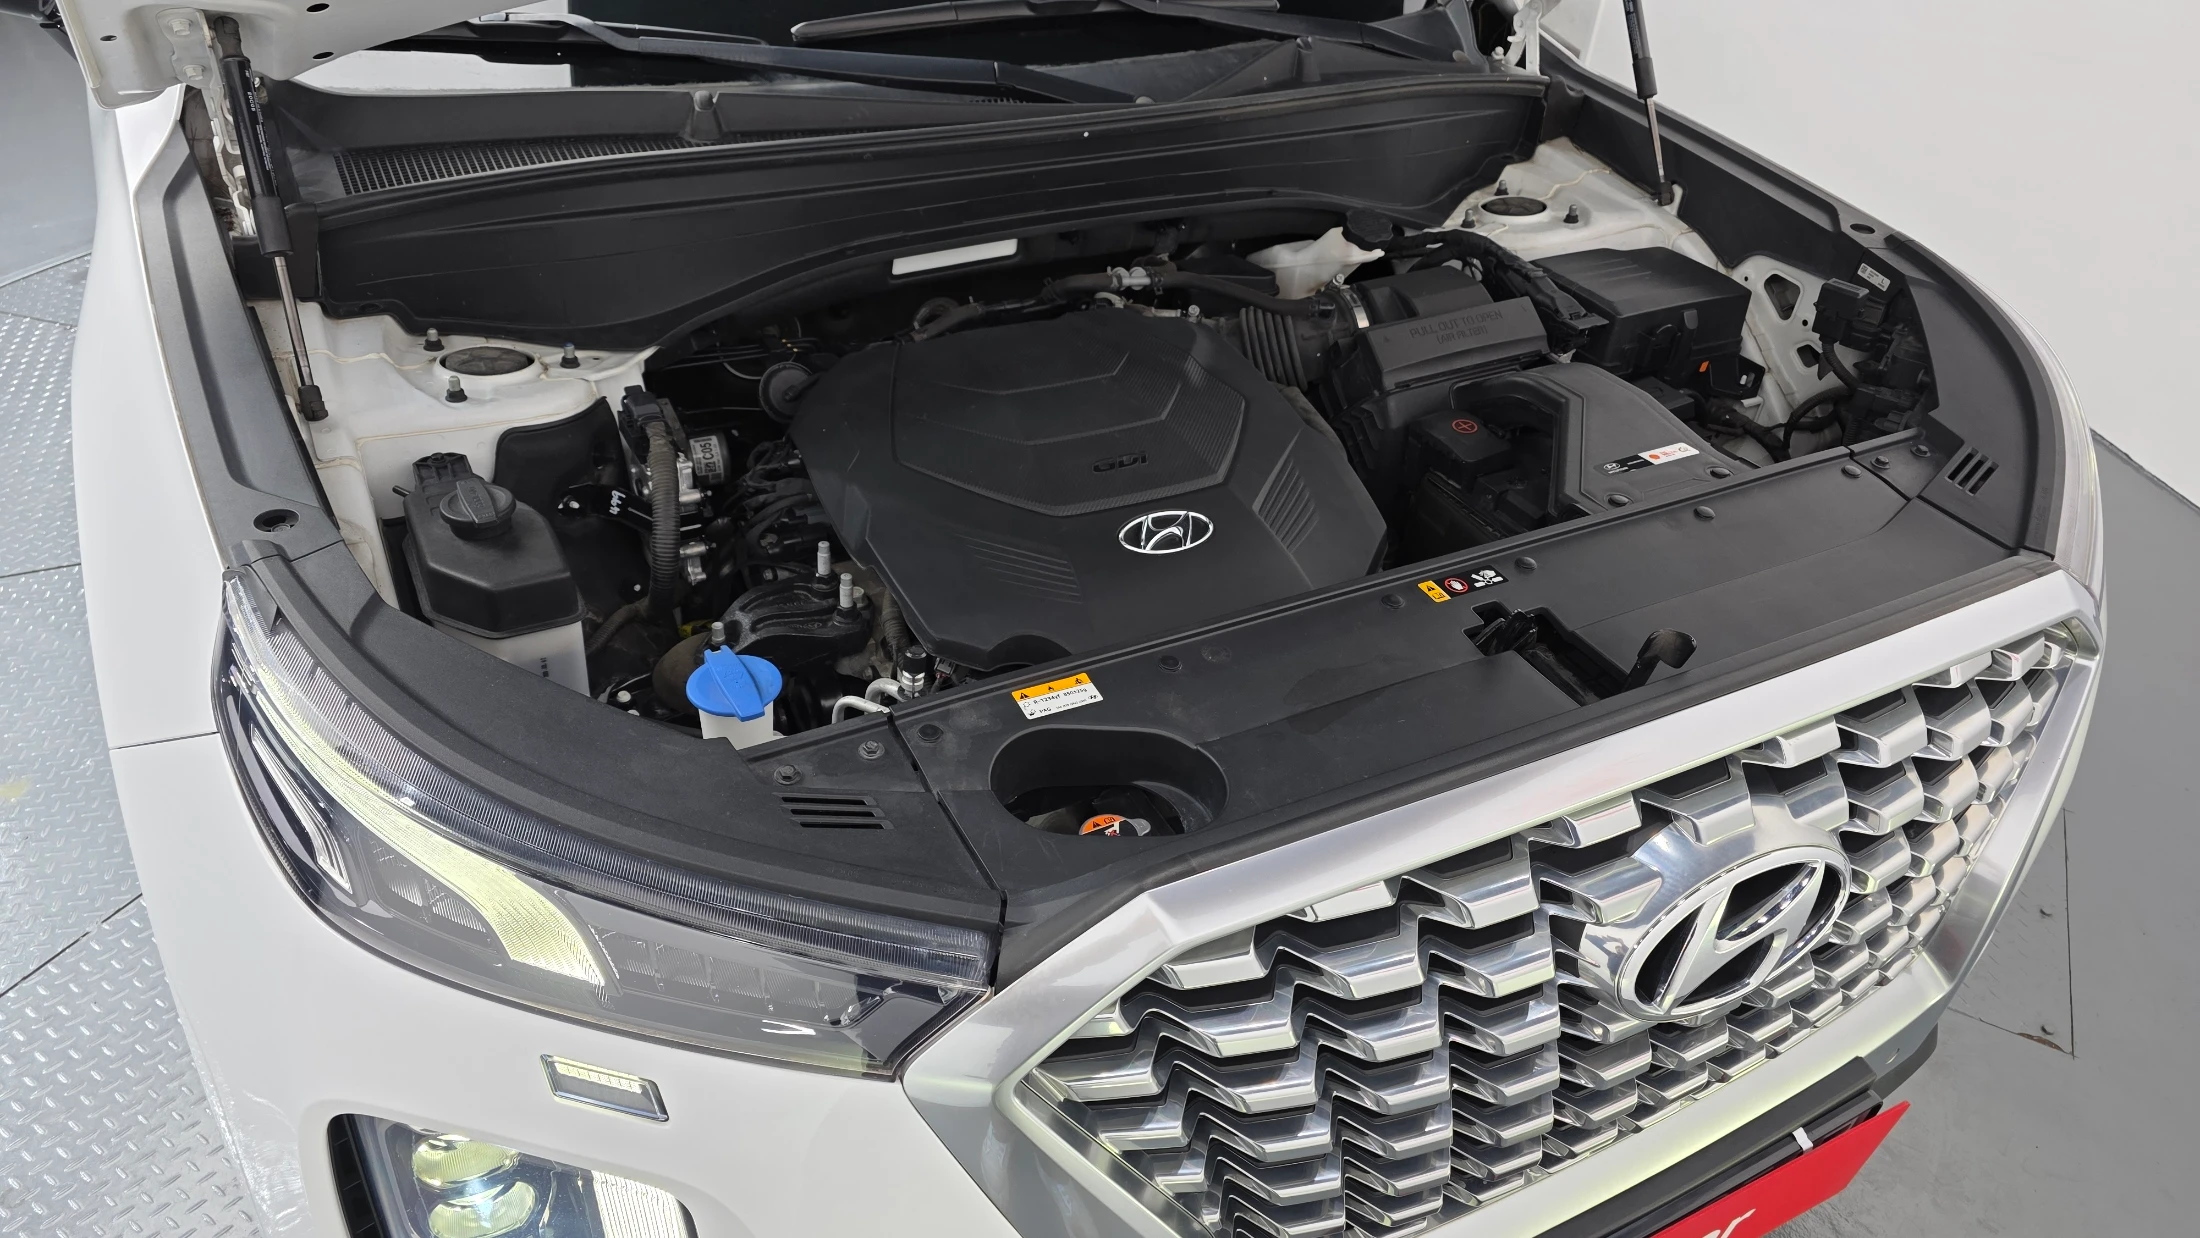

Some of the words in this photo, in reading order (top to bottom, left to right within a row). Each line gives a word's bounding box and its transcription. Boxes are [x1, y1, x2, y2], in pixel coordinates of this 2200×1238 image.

[1408, 325, 1437, 339] PULL
[1438, 318, 1459, 332] OUT
[1460, 315, 1474, 326] TO
[1475, 310, 1503, 323] OPEN
[699, 442, 715, 460] C05
[1092, 451, 1148, 473] GDI
